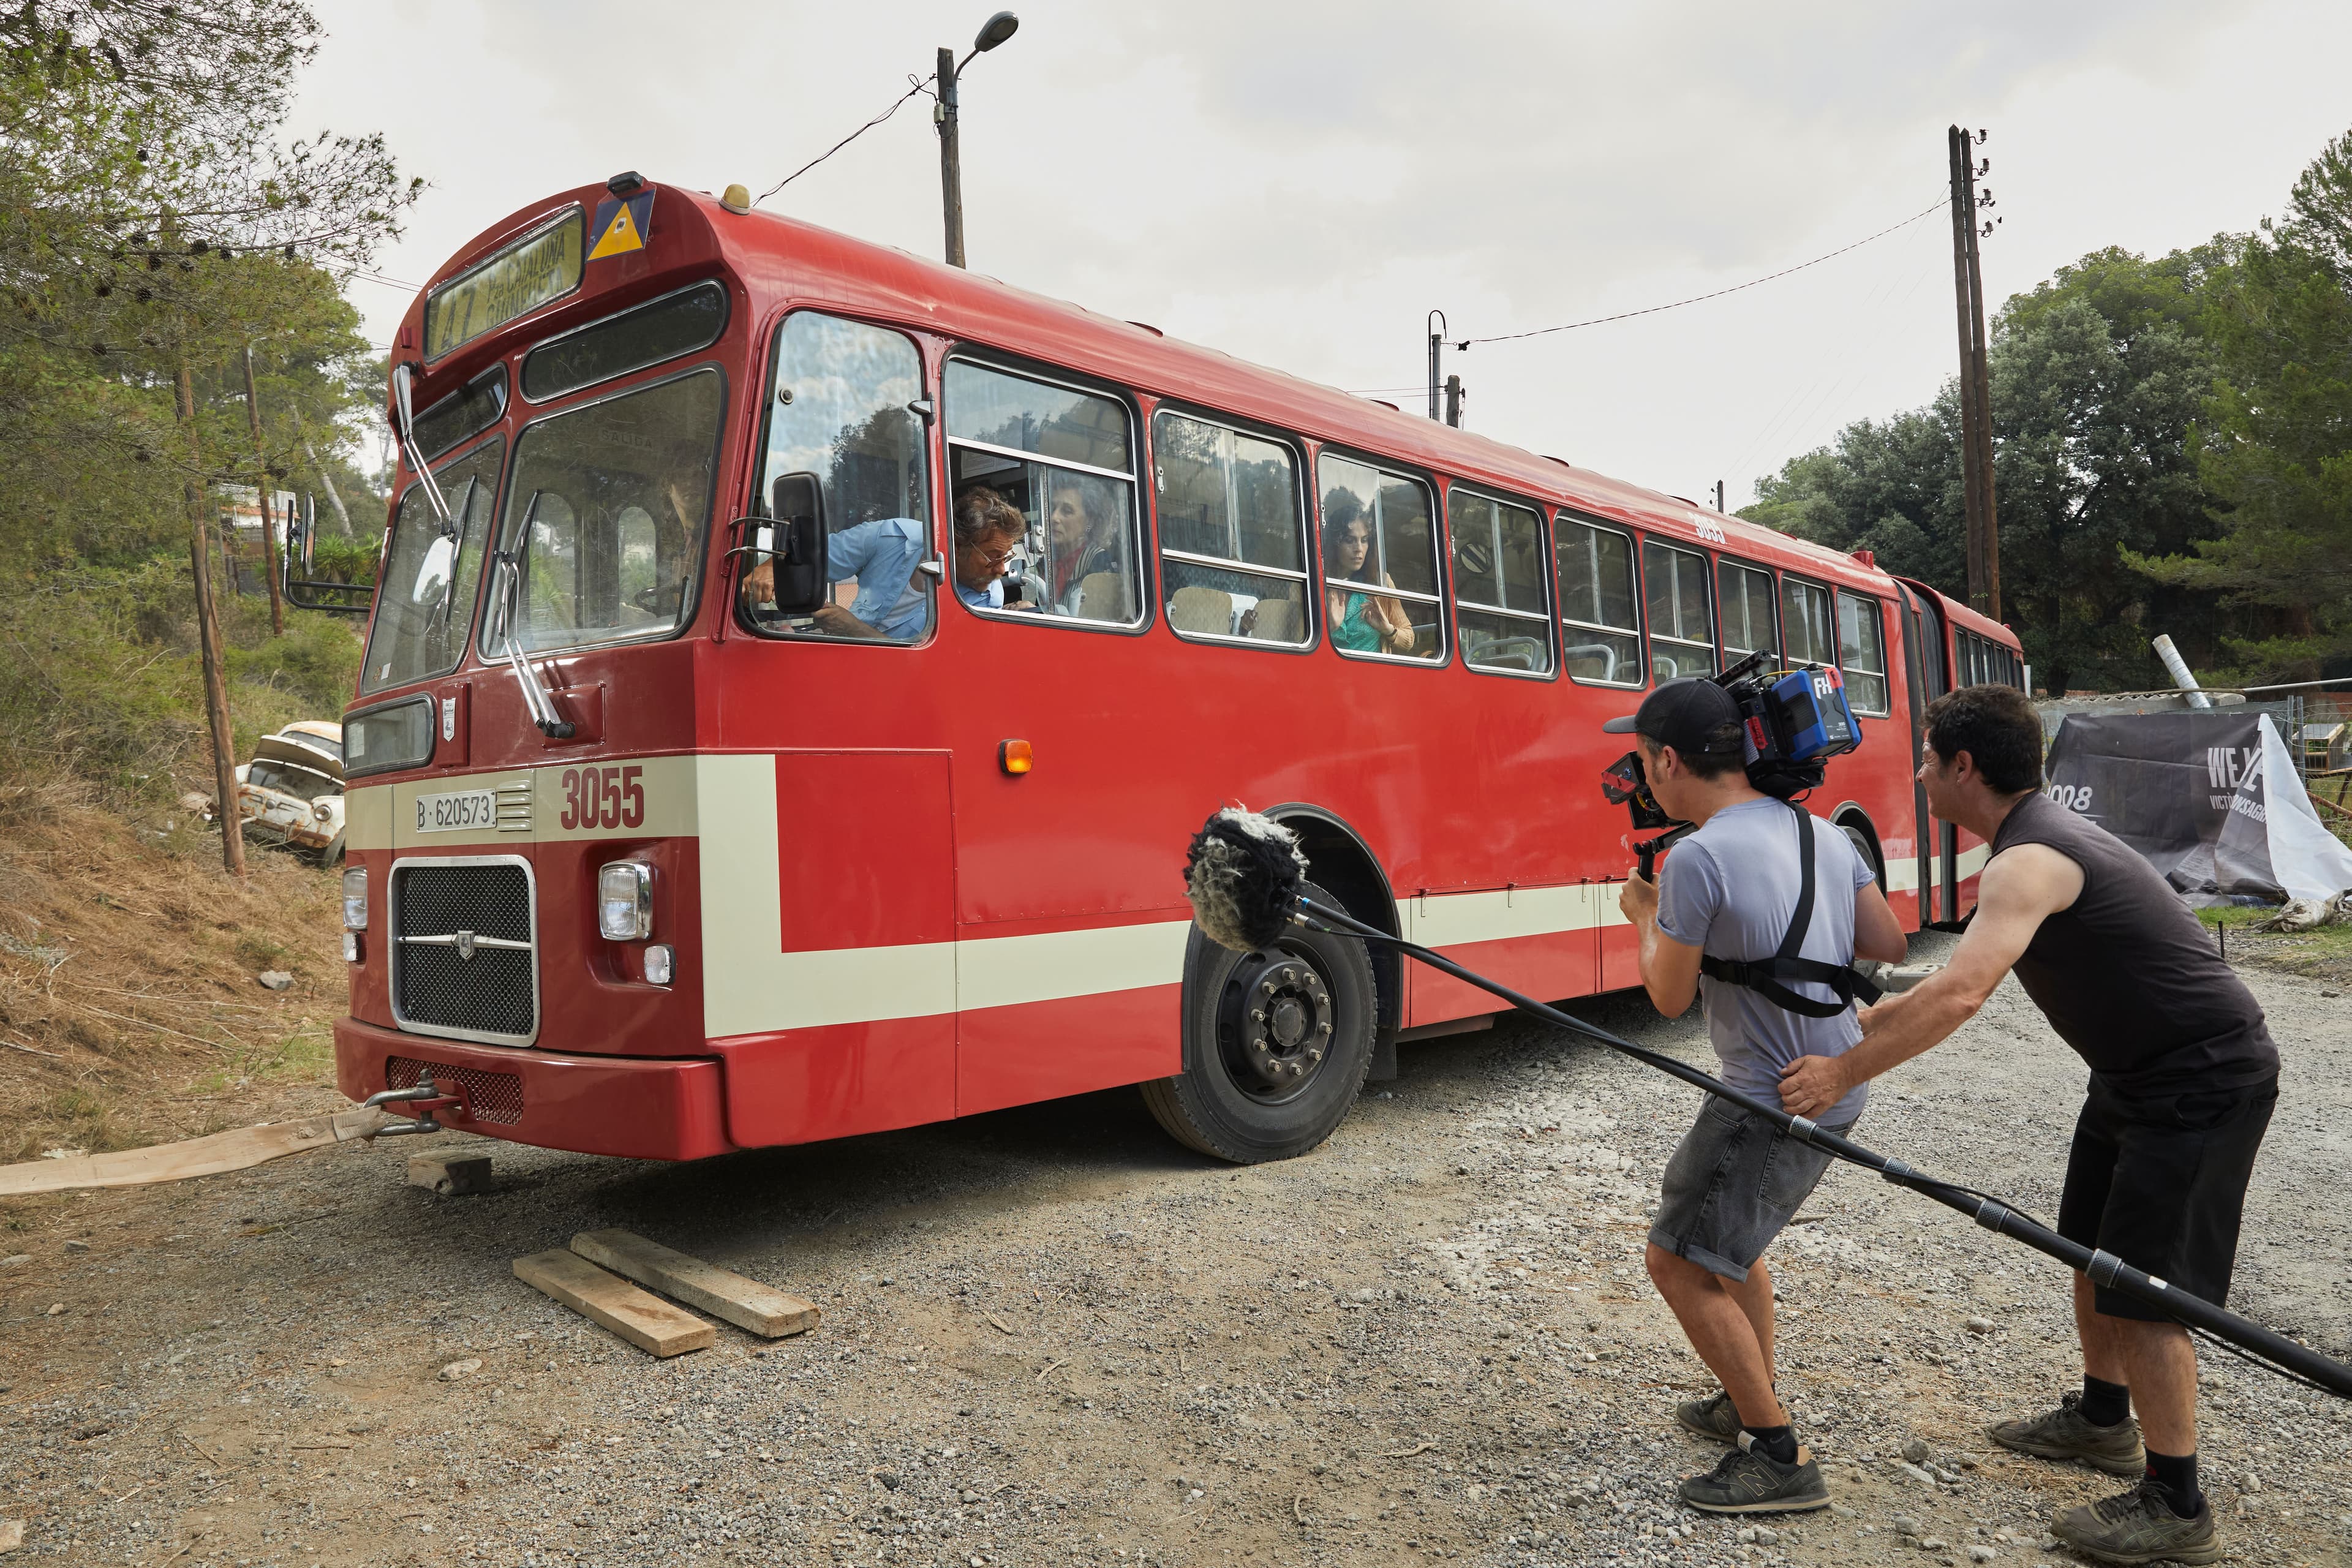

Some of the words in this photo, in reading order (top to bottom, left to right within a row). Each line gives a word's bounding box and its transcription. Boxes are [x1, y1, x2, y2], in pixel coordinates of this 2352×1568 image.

[440, 287, 477, 350] 47
[560, 766, 644, 830] 3055
[2046, 784, 2093, 811] 008
